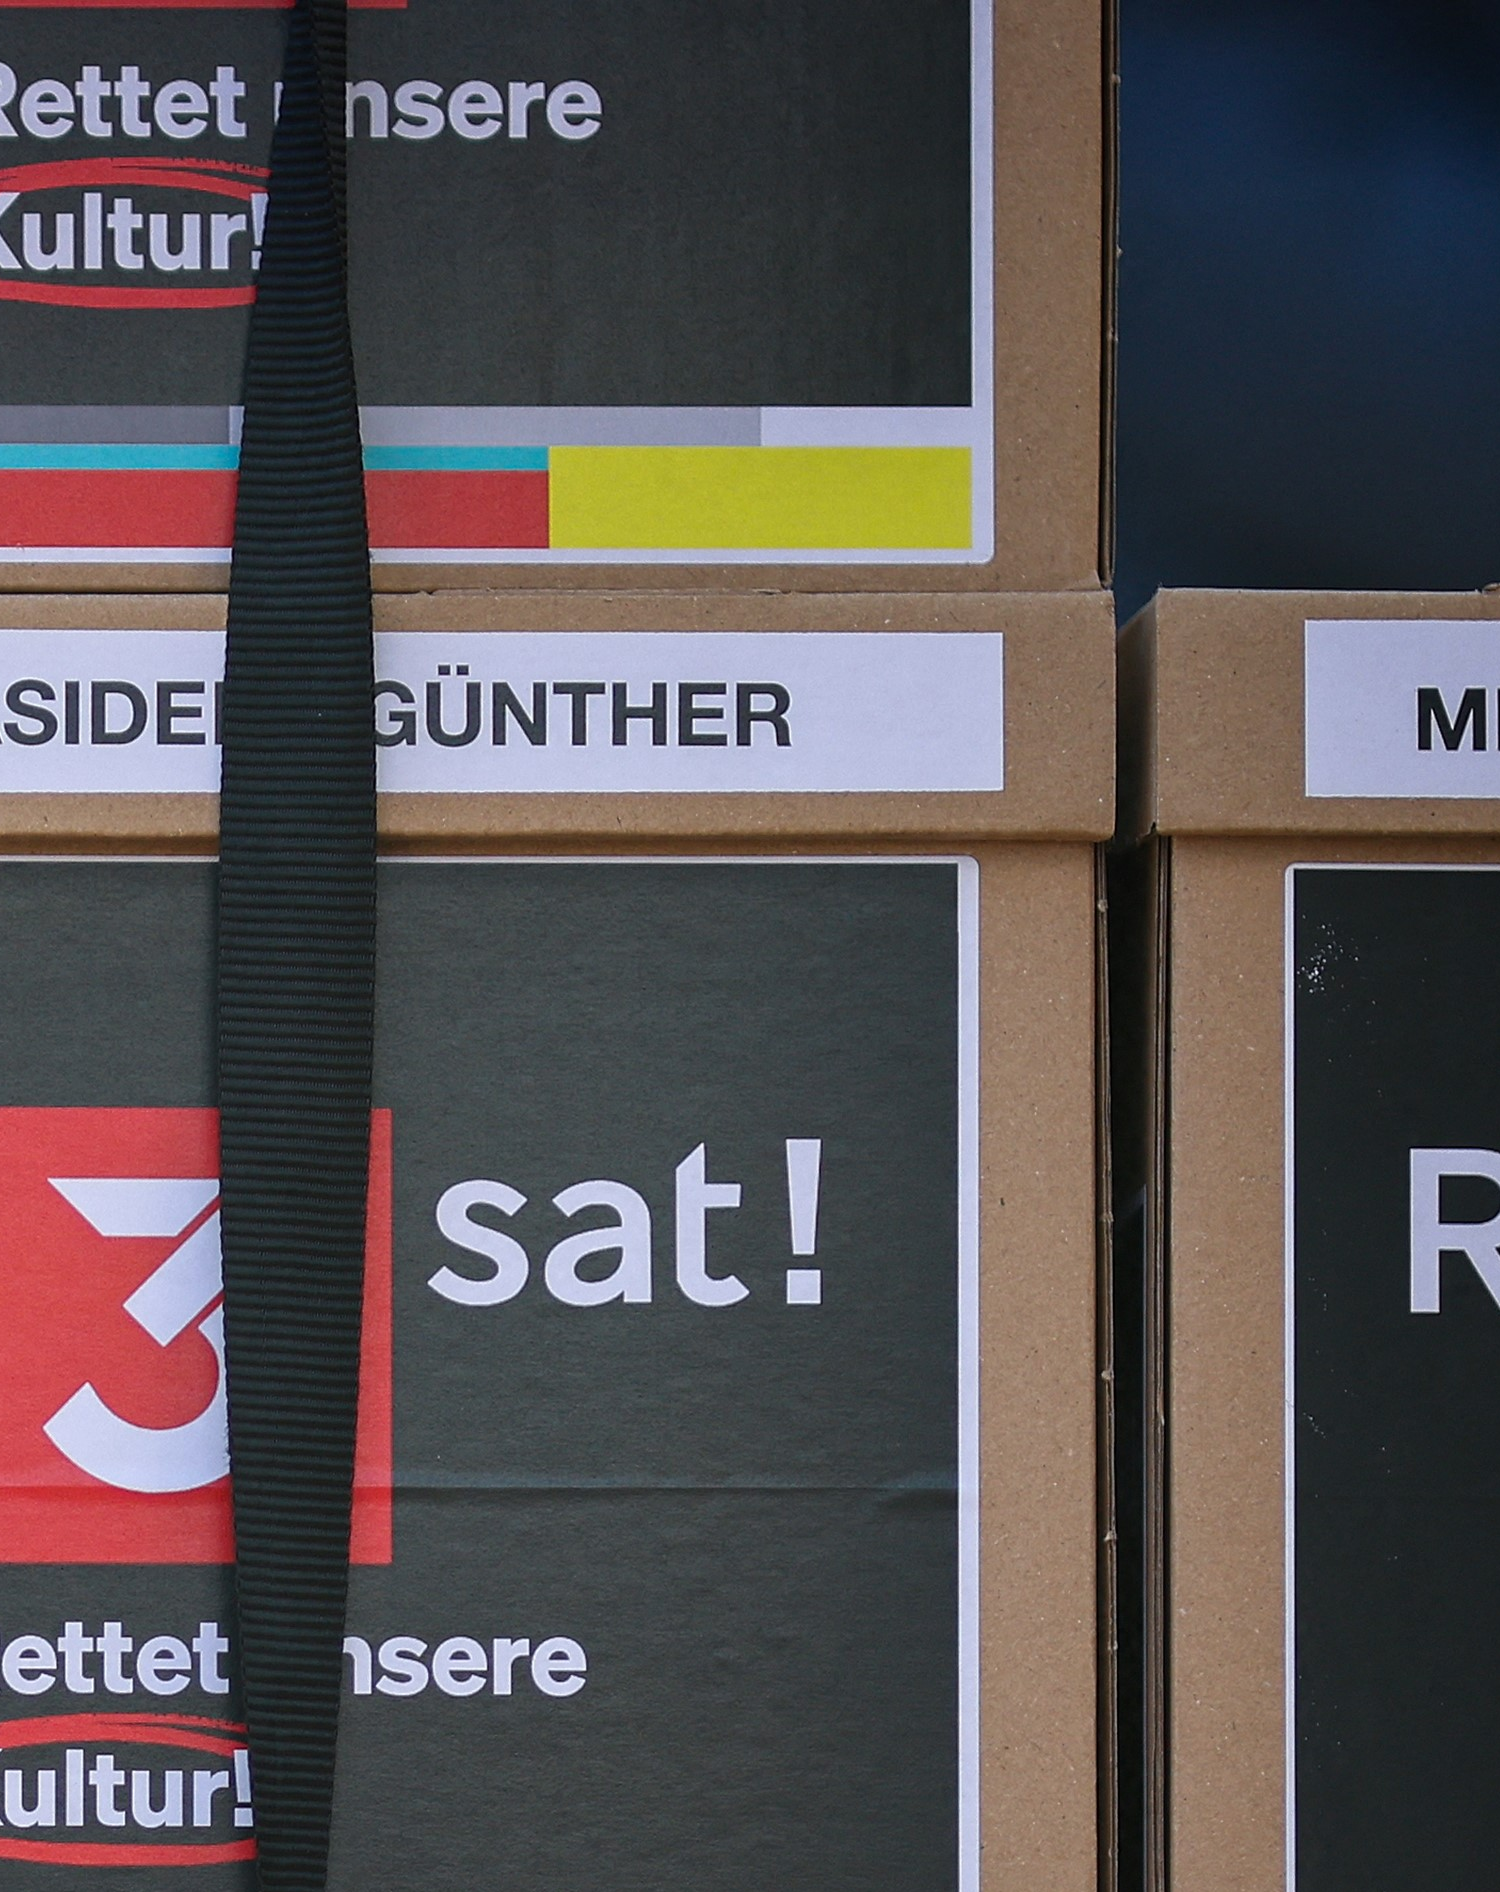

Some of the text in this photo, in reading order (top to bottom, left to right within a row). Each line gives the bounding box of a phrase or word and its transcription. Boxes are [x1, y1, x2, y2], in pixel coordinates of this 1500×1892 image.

[273, 79, 603, 142] nsere
[375, 663, 793, 749] GÜNTHER
[41, 1176, 232, 1495] 3
[426, 1137, 823, 1308] sat!
[341, 1635, 588, 1698] nsere
